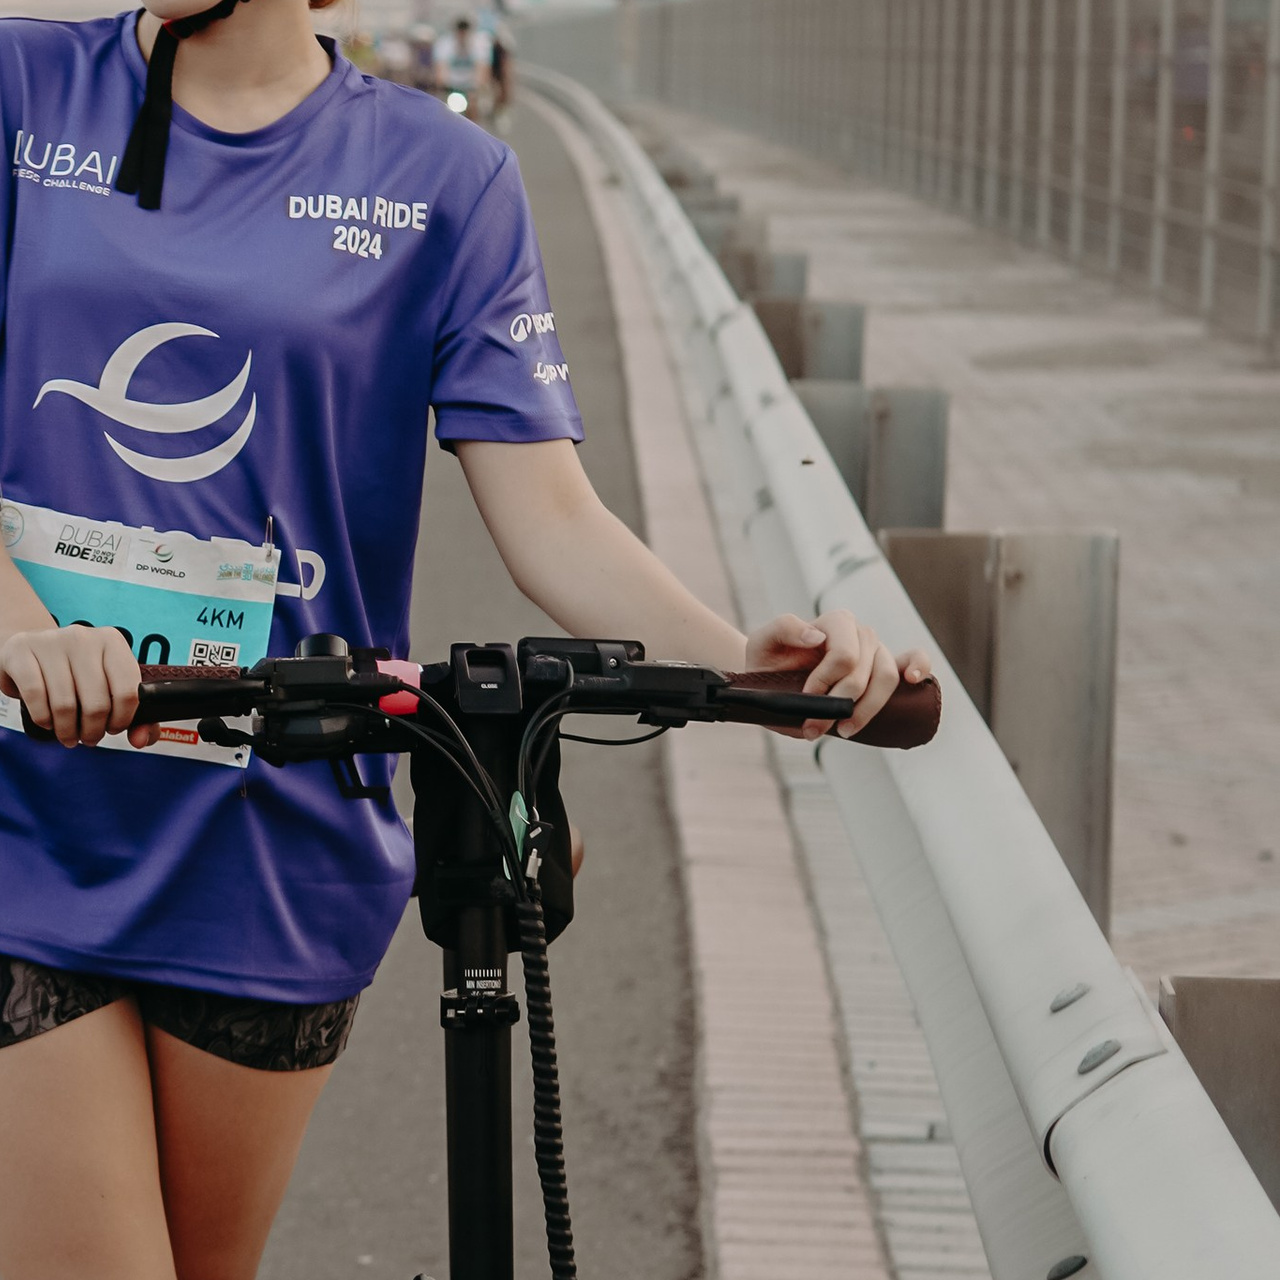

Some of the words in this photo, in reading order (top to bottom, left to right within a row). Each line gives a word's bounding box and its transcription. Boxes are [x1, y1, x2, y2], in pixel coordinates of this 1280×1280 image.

[43, 179, 111, 196] CHALLENGE
[289, 194, 368, 221] DUBAI
[372, 196, 428, 231] RIDE
[332, 225, 383, 260] 2024
[59, 524, 122, 551] DUBAI
[54, 541, 92, 560] RIDE
[90, 554, 114, 565] 2024
[135, 563, 149, 571] DP
[150, 566, 186, 579] WORLD
[196, 606, 245, 630] 4KM
[160, 729, 195, 742] alabat
